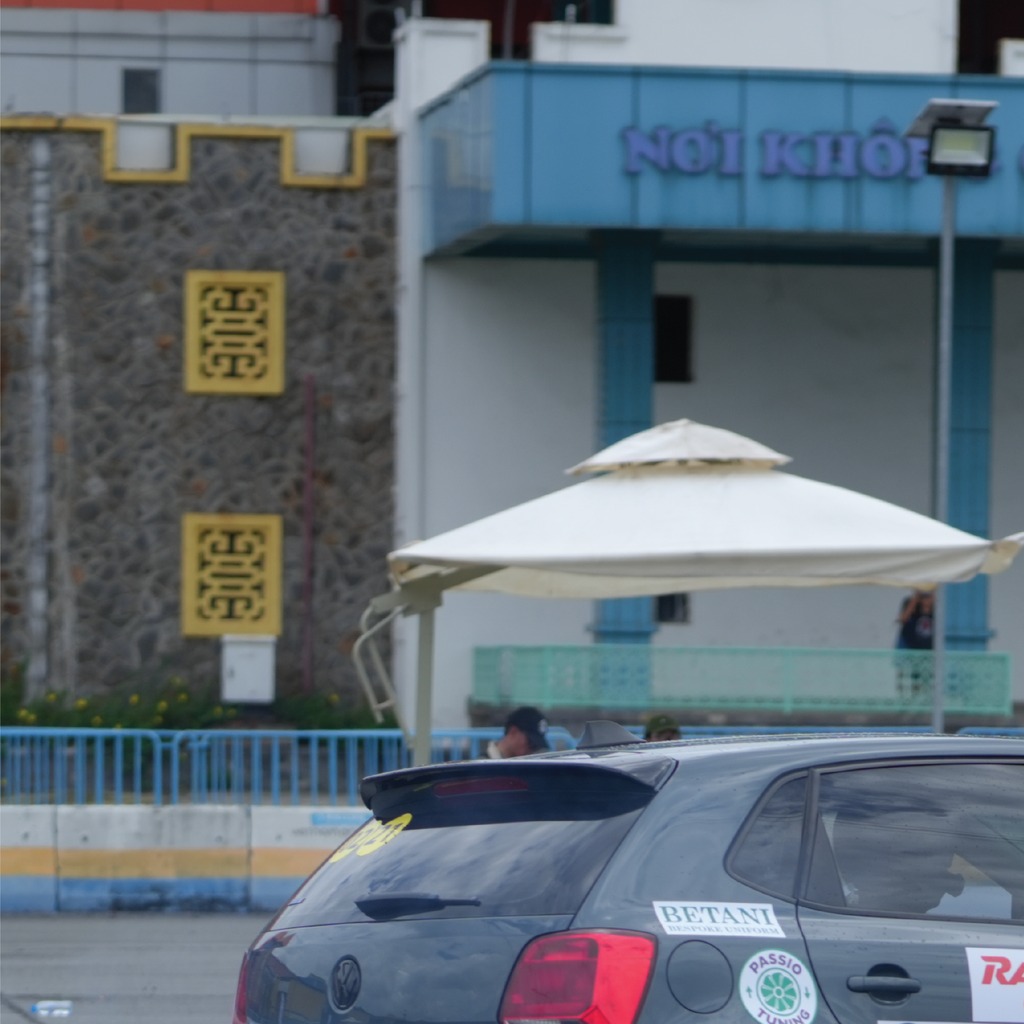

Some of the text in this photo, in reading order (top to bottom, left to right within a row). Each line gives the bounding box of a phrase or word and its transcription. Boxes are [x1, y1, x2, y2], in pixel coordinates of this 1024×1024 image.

[762, 119, 1000, 178] KHÔ
[658, 905, 776, 926] BETANI
[749, 953, 803, 976] PASSIO
